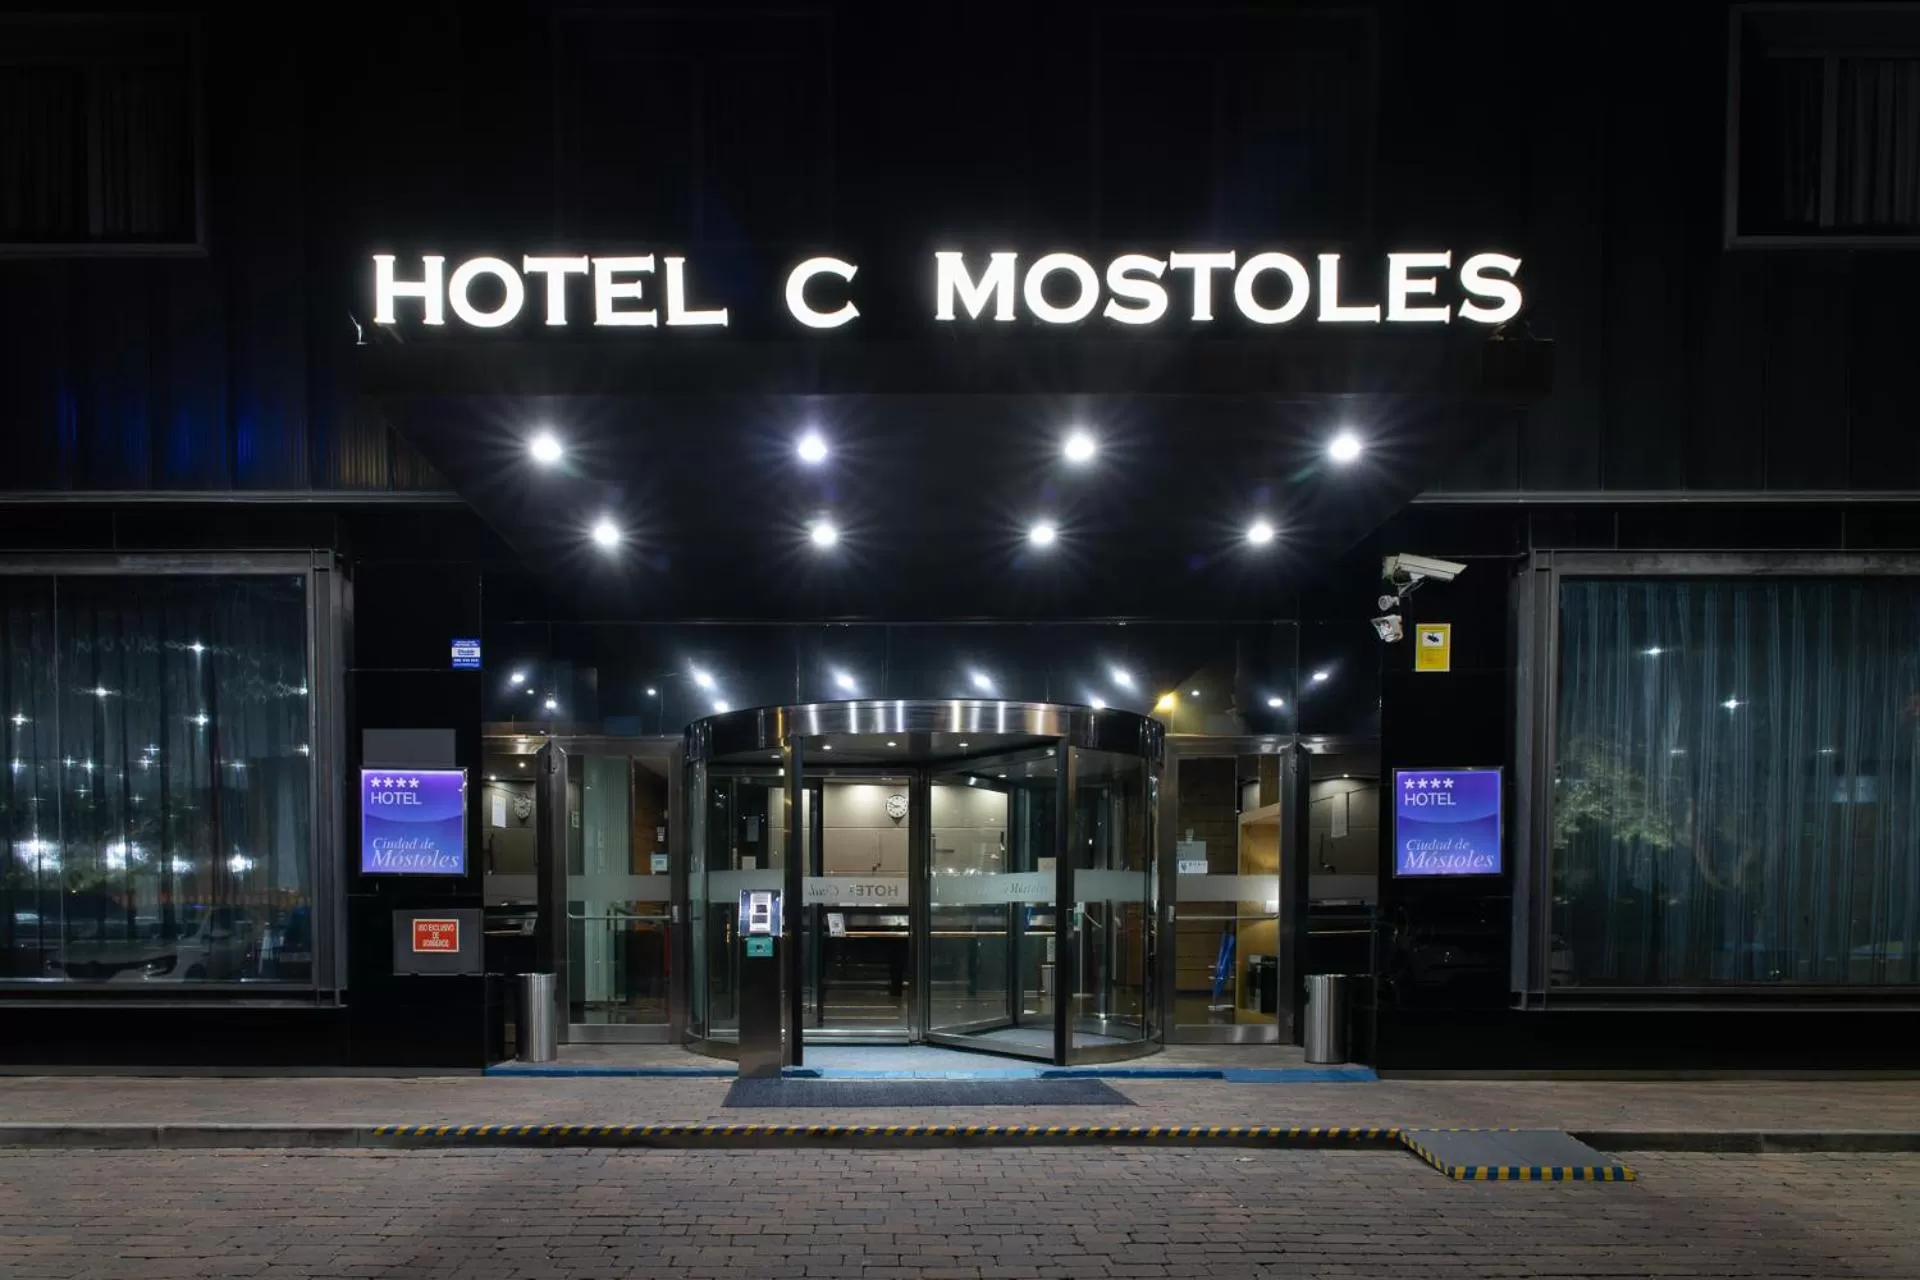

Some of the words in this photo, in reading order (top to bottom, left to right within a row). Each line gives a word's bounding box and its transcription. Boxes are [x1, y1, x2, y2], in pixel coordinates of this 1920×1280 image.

[372, 253, 729, 328] HOTEL
[785, 256, 861, 328] C
[934, 250, 1522, 325] MOSTOLES
[370, 791, 423, 805] HOTEL
[1404, 792, 1457, 806] HOTEL
[372, 836, 418, 849] Ciudad
[420, 837, 436, 849] de
[1405, 838, 1453, 851] Ciudad
[1454, 837, 1471, 850] de
[371, 848, 460, 868] Móstoles
[1404, 849, 1495, 869] Móstoles
